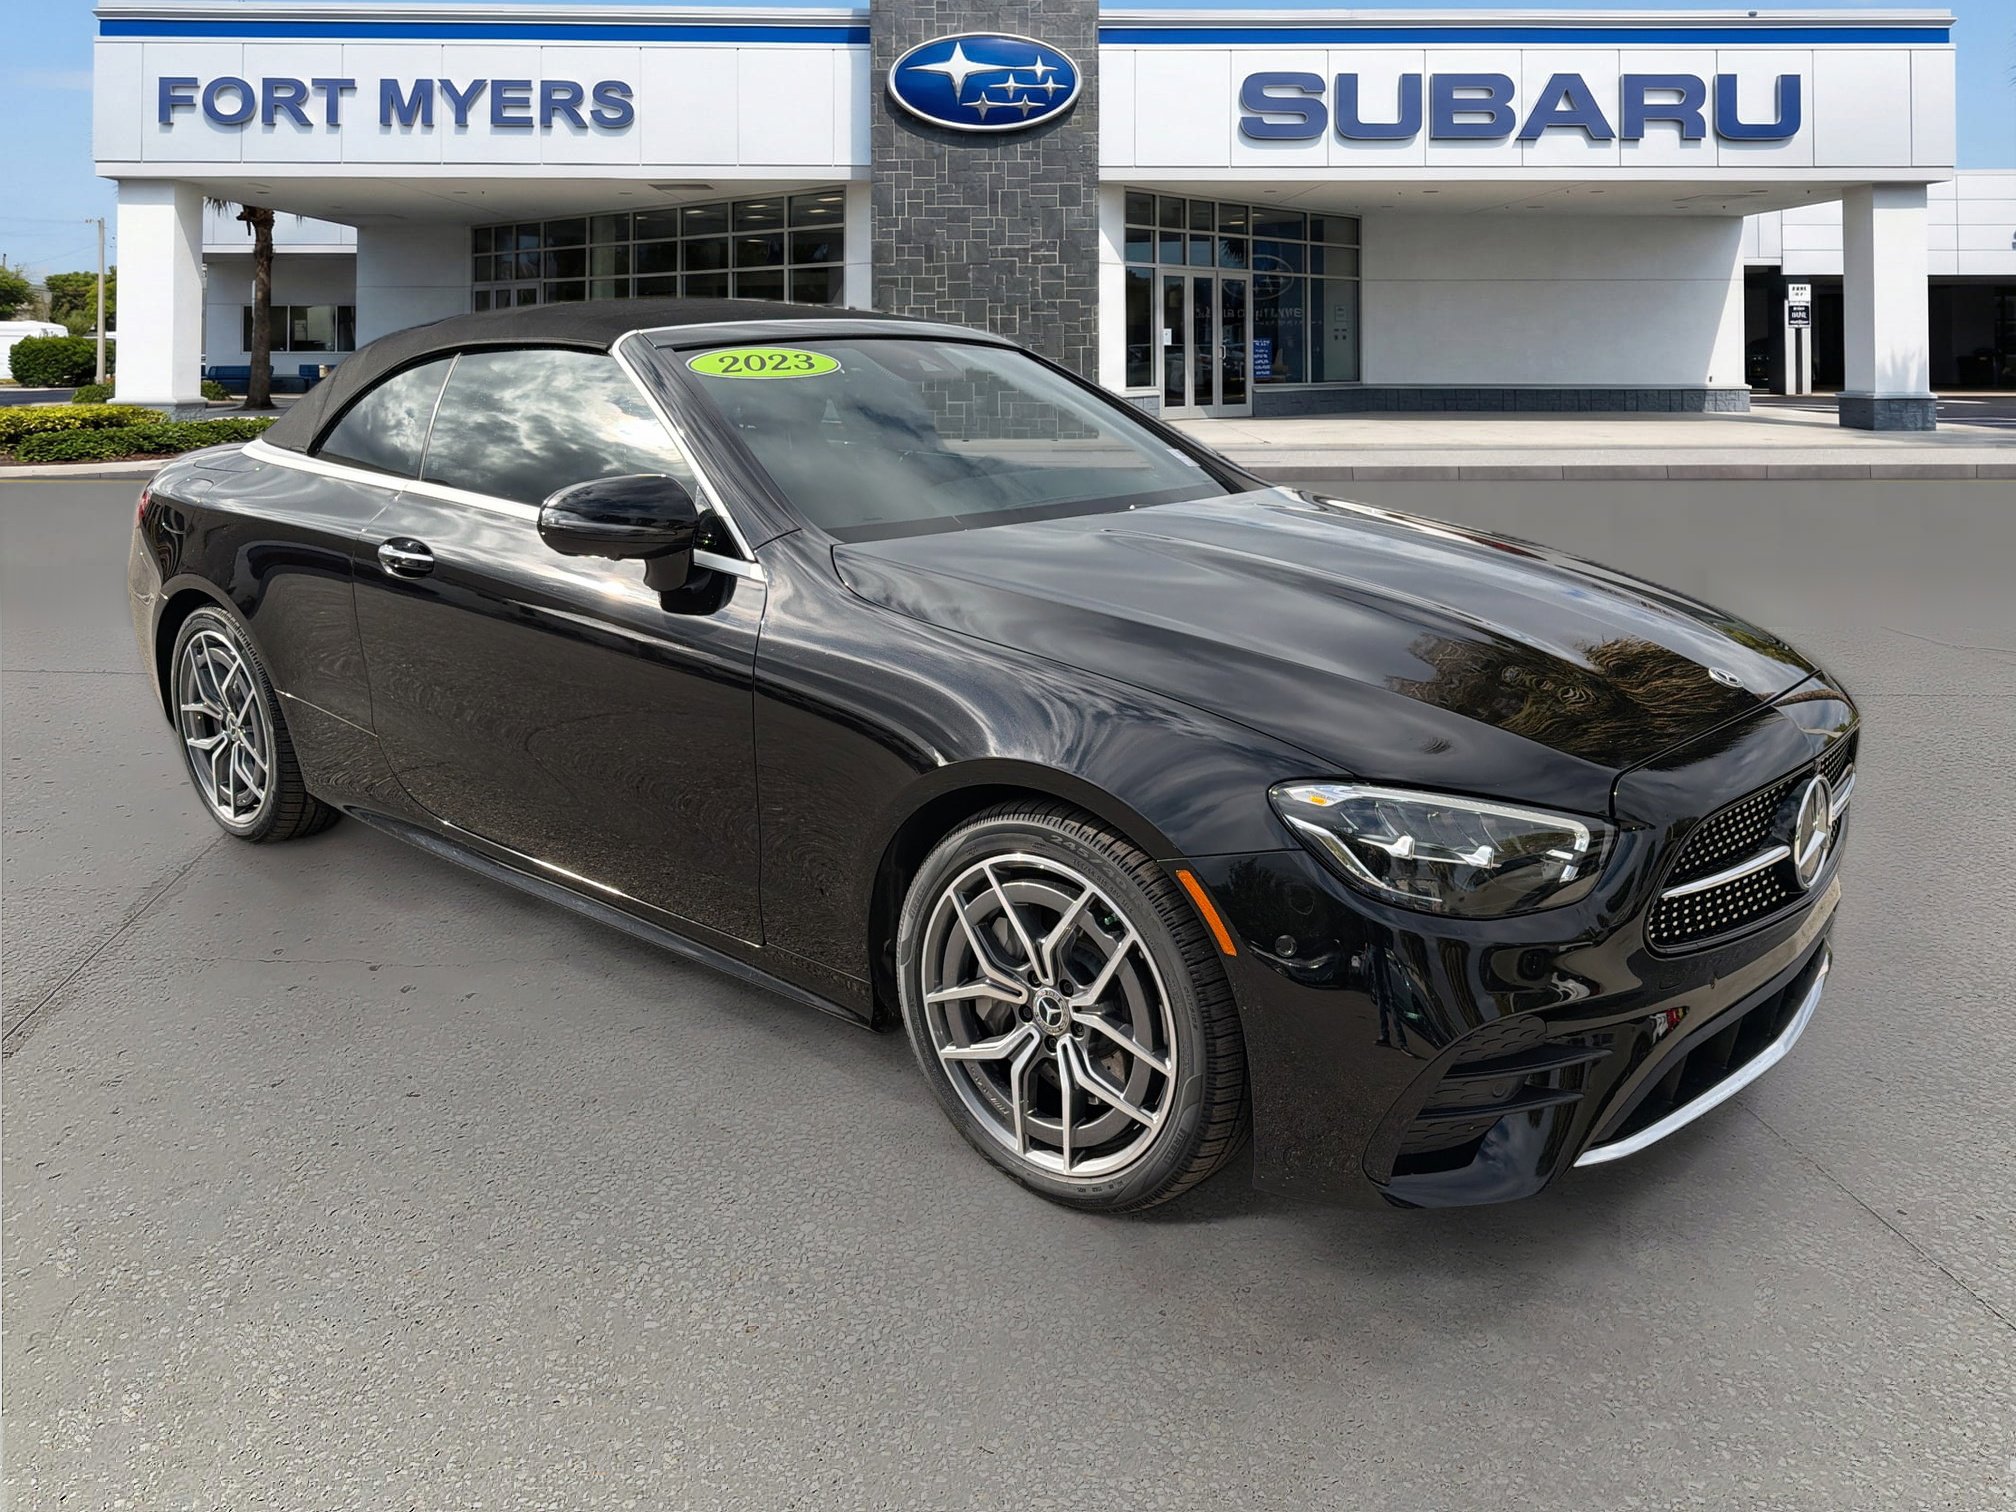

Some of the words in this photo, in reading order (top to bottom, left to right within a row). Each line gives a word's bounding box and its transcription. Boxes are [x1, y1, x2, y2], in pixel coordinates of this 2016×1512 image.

[158, 76, 357, 127] FORT
[379, 78, 635, 129] MYERS
[1240, 71, 1801, 142] SUBARU
[718, 353, 815, 373] 2023
